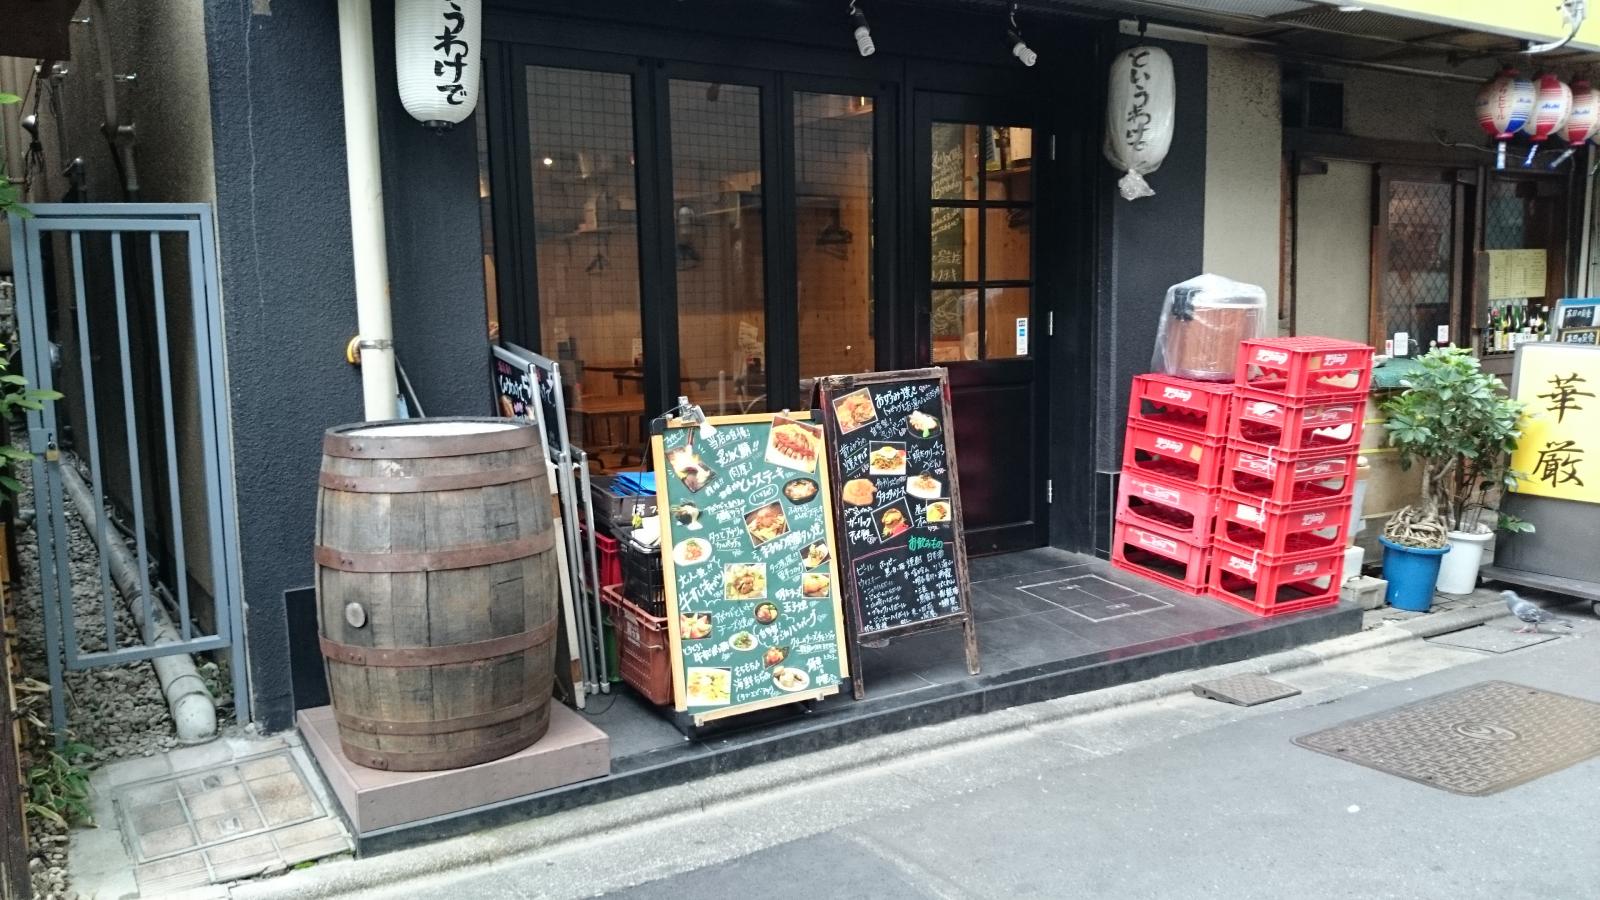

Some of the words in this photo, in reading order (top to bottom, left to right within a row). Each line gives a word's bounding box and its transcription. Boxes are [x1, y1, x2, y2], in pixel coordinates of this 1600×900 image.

[433, 0, 468, 105] うわけで
[1533, 372, 1595, 487] 華厳
